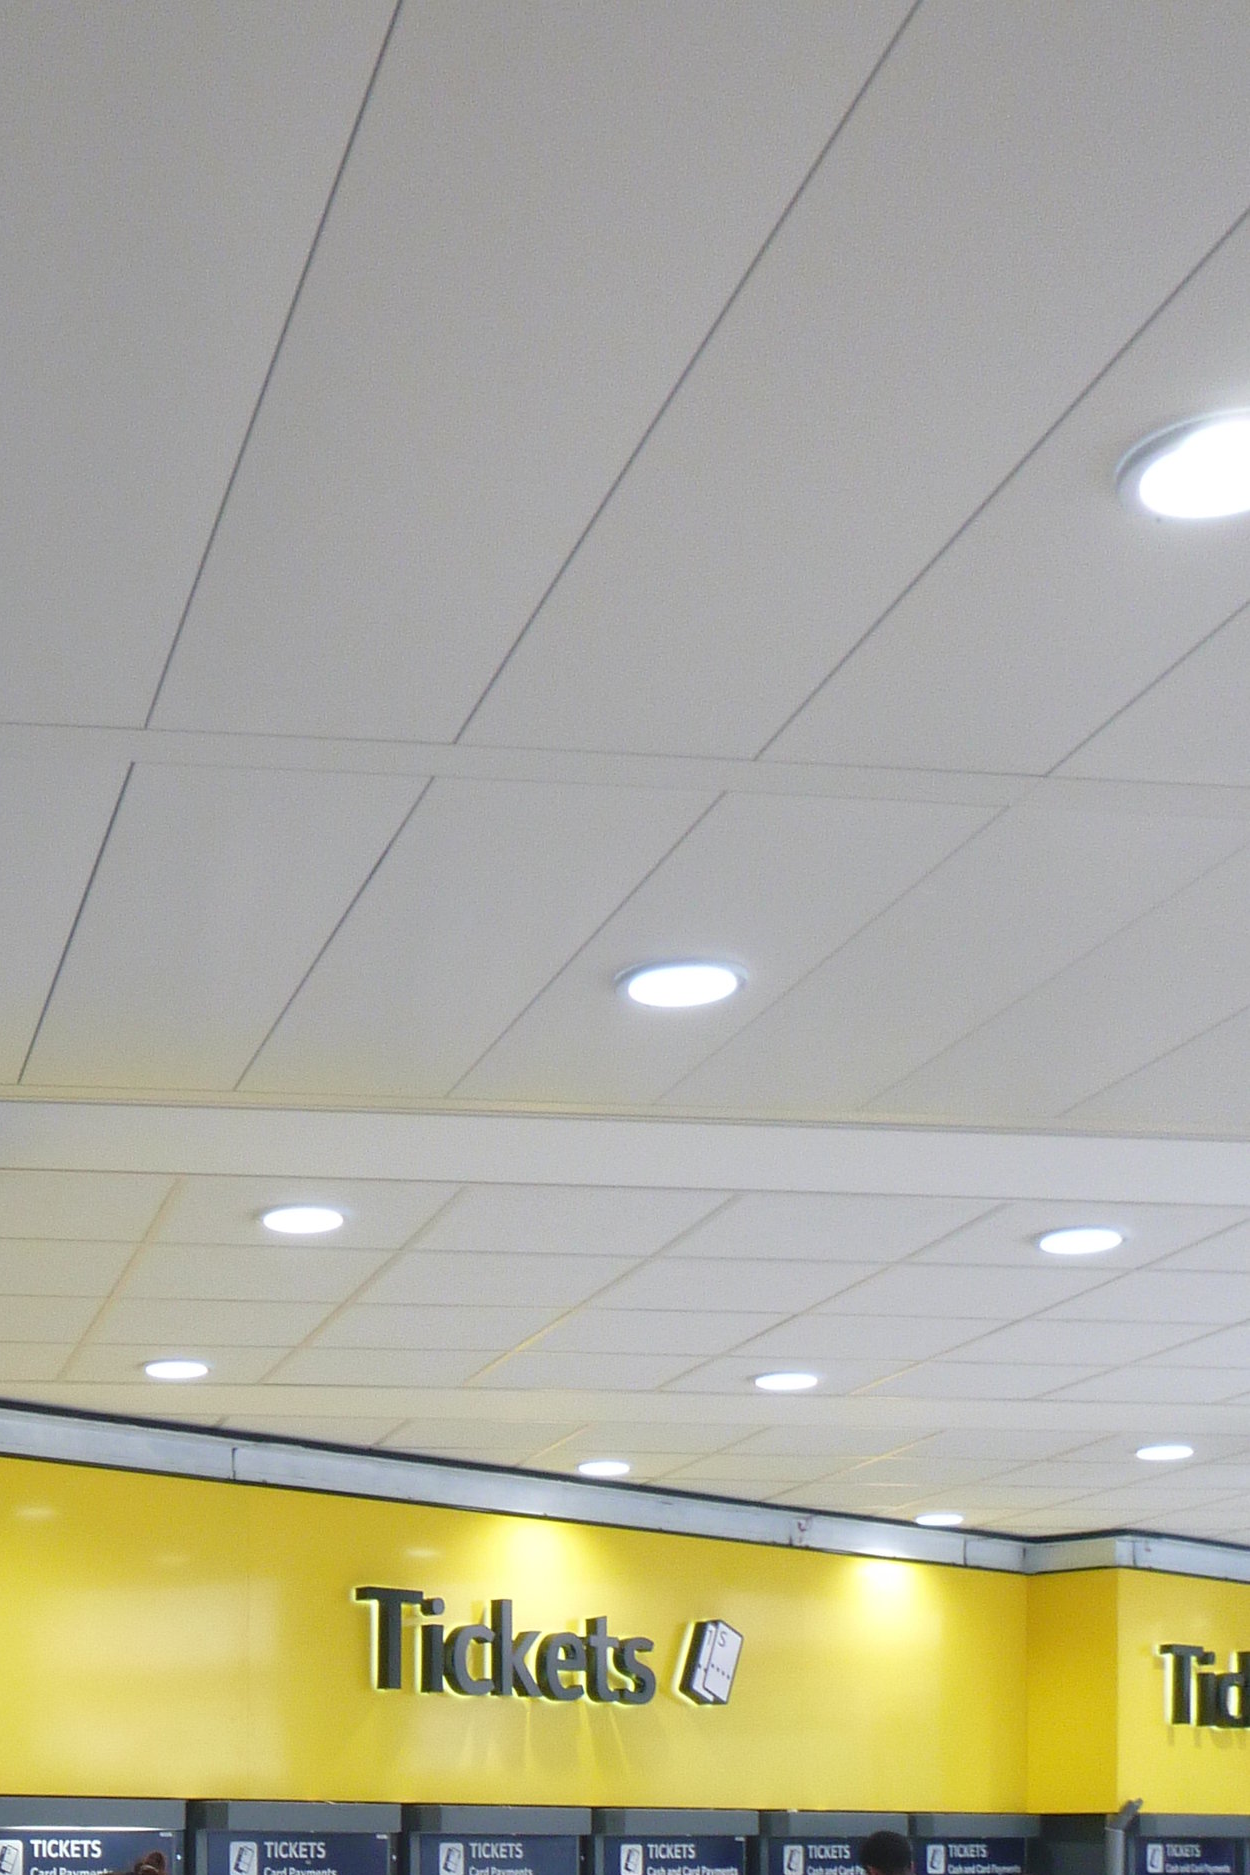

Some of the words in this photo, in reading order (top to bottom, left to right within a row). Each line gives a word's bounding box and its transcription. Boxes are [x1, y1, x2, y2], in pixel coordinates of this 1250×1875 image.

[355, 1587, 656, 1705] Tickets
[30, 1839, 102, 1858] TICKETS
[264, 1842, 326, 1858] TICKETS
[469, 1842, 523, 1859] TICKETS
[647, 1844, 696, 1859] TICKETS
[807, 1845, 850, 1859] TICKETS
[948, 1844, 988, 1858] TICKETS
[1166, 1844, 1201, 1857] TICKETS
